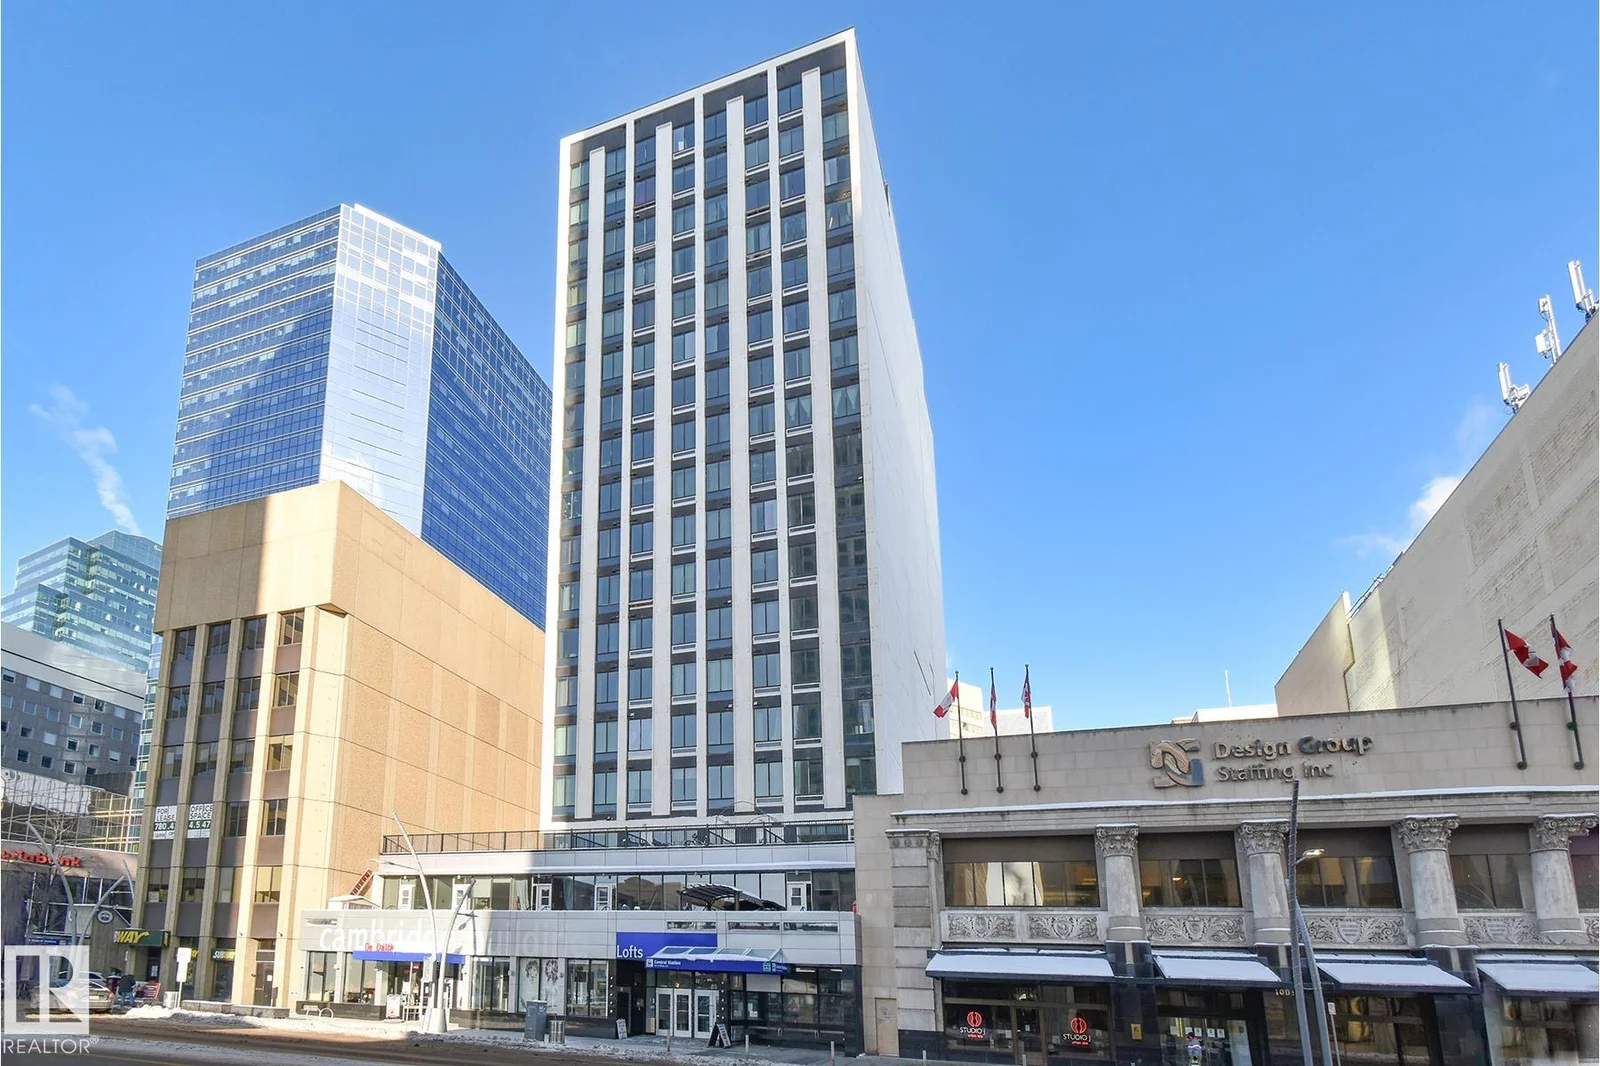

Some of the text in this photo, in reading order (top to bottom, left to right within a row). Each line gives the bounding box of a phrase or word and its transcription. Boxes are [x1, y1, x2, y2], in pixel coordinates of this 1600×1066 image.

[1214, 735, 1374, 761] Design Group
[1217, 762, 1296, 783] Staffing
[191, 804, 214, 812] OFFICE
[156, 814, 176, 822] LEASE
[190, 812, 212, 820] SPACE
[616, 944, 644, 959] Lofts
[960, 1026, 982, 1035] STUDIO
[1062, 1033, 1087, 1041] STUDIO
